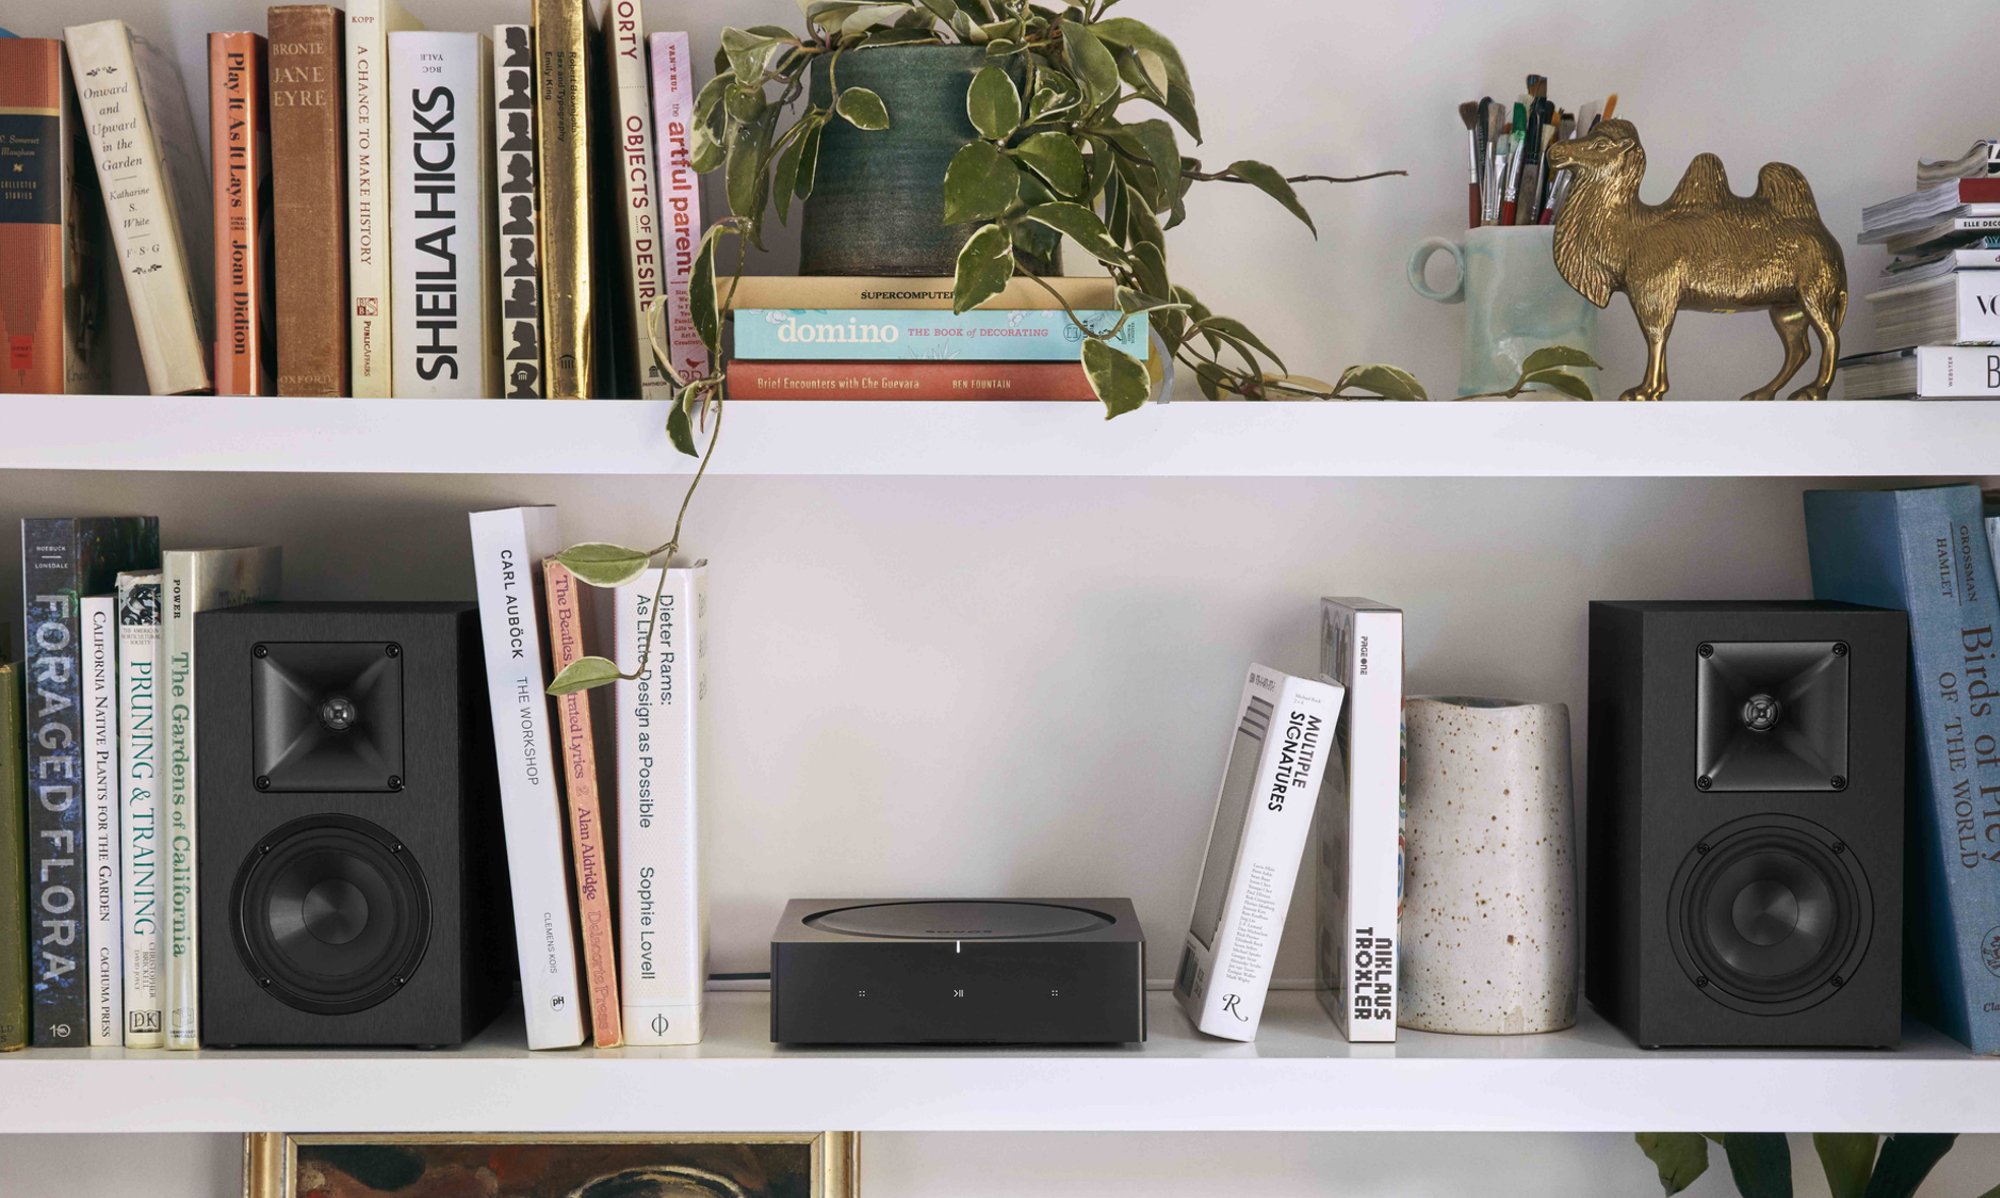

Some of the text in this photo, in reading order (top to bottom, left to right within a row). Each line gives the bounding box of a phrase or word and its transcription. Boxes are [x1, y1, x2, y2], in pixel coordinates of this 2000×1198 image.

[274, 66, 325, 83] JANE
[544, 51, 553, 100] Emily King
[569, 52, 577, 82] Robert
[668, 45, 677, 72] VAN'T
[84, 82, 128, 99] Onward
[99, 103, 119, 115] and
[274, 90, 327, 107] EYRE
[557, 89, 566, 142] Typography
[672, 103, 680, 117] the
[1, 147, 35, 158] Maugham
[9, 135, 39, 144] Somerset
[91, 118, 137, 138] Upward
[102, 139, 133, 153] in the
[223, 53, 246, 208] Play It As It Lays
[102, 158, 143, 171] Garden
[357, 45, 372, 265] A CHANCE TO MAKE HISTORY
[668, 122, 692, 191] artful
[5, 192, 32, 200] STORIES
[110, 187, 150, 200] Katharine
[129, 203, 137, 212] S.
[624, 116, 656, 312] OBJECTS OF DESIRE
[123, 218, 150, 229] White
[412, 86, 458, 381] SHEILA HICKS
[668, 197, 692, 276] parent
[232, 240, 249, 354] Joan Didion
[778, 317, 1049, 343] domino THE BOOK of DECORATING
[280, 375, 331, 384] OXFORD
[757, 377, 1011, 389] Brief Encounters with Che Guevara BEN FOUNTAIN
[1937, 538, 1953, 598] HAMLET
[1960, 525, 1977, 602] GROSSMAN
[173, 579, 181, 619] POWER
[556, 575, 568, 606] The
[637, 594, 651, 616] As
[559, 609, 572, 661] Beatles
[659, 595, 675, 706] Dieter Rams:
[500, 550, 539, 785] CARL AUBÖCK THE WORKSHOP
[1961, 625, 2000, 717] Birds
[635, 669, 653, 728] Design
[93, 611, 112, 921] CALIFORNIA NATIVE PLANTS FOR THE GARDEN
[569, 730, 584, 779] Lyrics
[638, 733, 650, 752] as
[1268, 710, 1305, 812] SIGNATURES
[1292, 715, 1322, 789] MULTIPLE
[1974, 735, 2000, 768] of
[36, 595, 76, 981] FORAGED FLORA
[639, 758, 654, 828] Possible
[1938, 672, 1979, 869] OF THE WORLD
[129, 661, 156, 935] PRUNING & TRAINING
[171, 652, 191, 957] The Gardens of California
[578, 807, 592, 840] Alan
[582, 844, 598, 901] Aldridge
[544, 912, 557, 974] CLEMENS KOIS
[637, 866, 656, 979] Sophie Lovell
[100, 947, 110, 1038] CACHUMA PRESS
[1354, 927, 1373, 1020] TROXLER
[1374, 938, 1393, 1020] NIKLAUS
[134, 1012, 157, 1028] DK
[1222, 993, 1248, 1022] R
